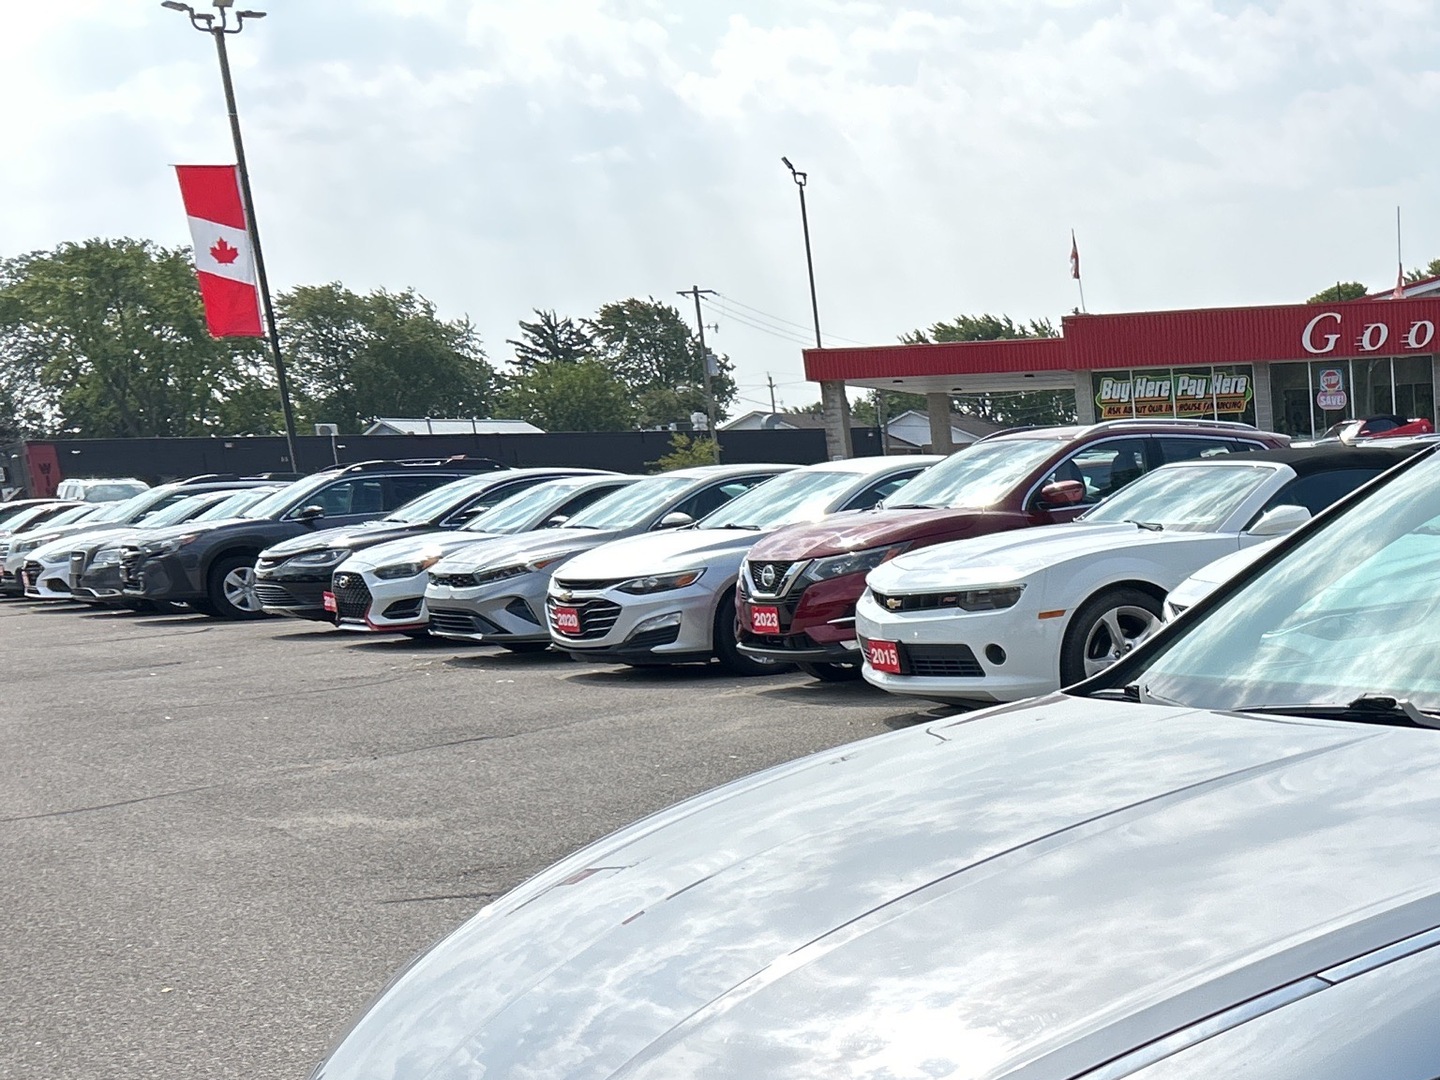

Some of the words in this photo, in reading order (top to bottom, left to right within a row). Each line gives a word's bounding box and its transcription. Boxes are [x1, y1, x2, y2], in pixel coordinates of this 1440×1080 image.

[1101, 380, 1131, 403] Buy
[1134, 378, 1170, 399] Here
[1177, 376, 1206, 399] Pay
[1209, 374, 1247, 396] Here
[1107, 406, 1121, 415] ASK
[1148, 404, 1163, 413] OUR
[557, 613, 578, 627] 2020
[754, 612, 778, 627] 2023
[871, 647, 898, 666] 2015
